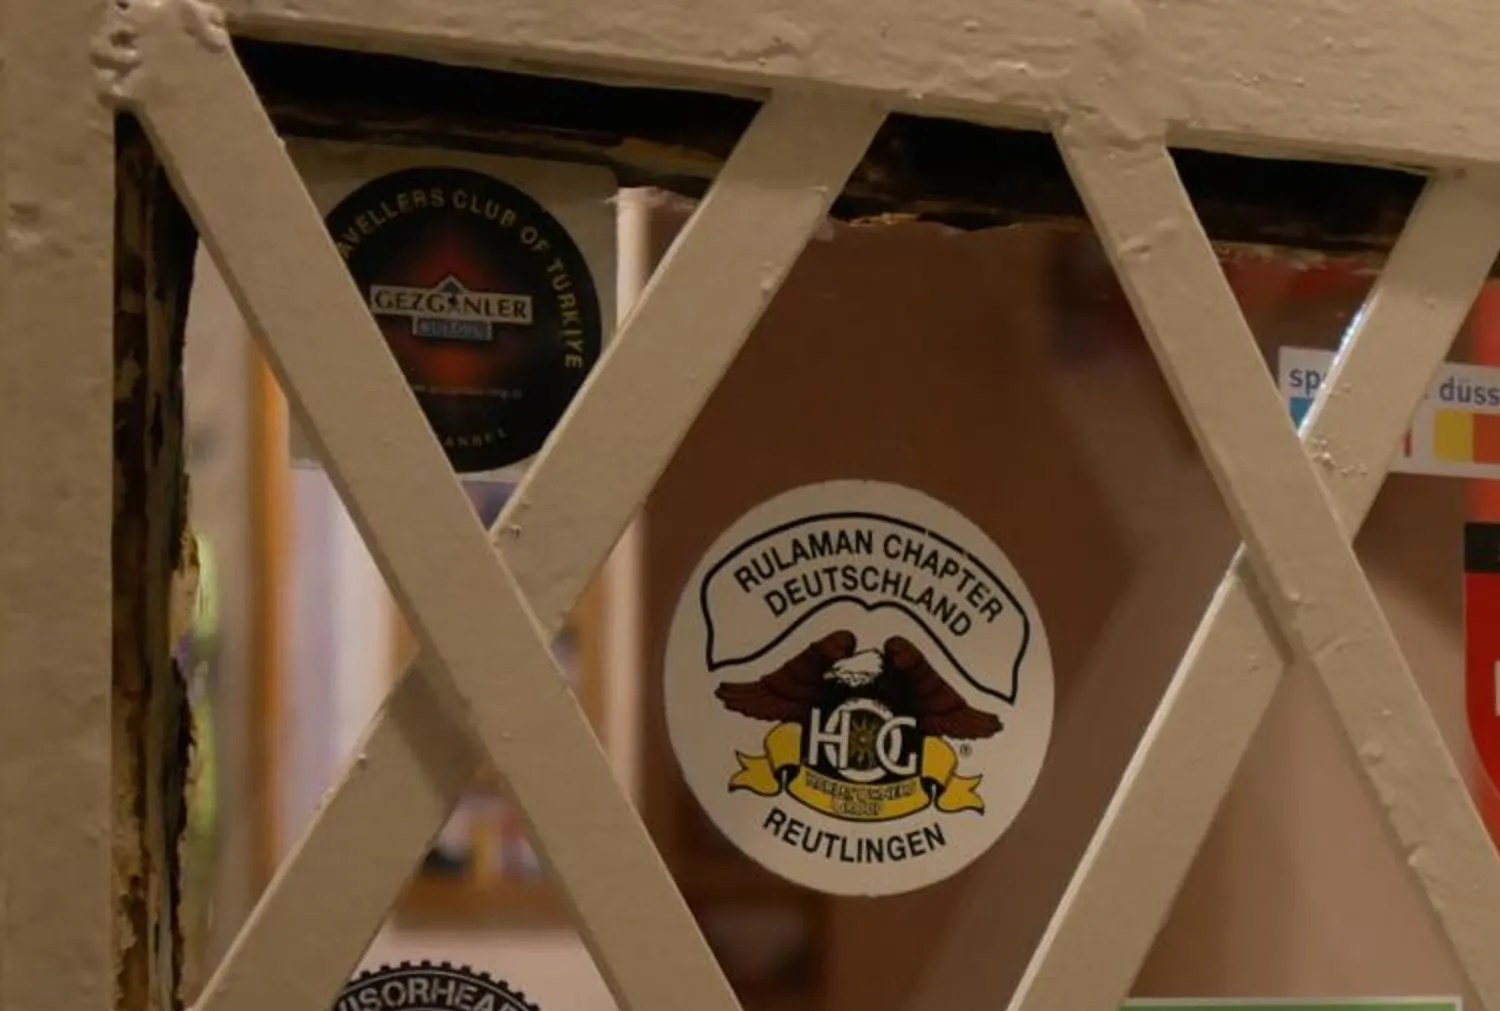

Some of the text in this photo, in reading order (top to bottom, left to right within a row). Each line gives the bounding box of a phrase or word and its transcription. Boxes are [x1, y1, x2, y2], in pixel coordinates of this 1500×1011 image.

[337, 187, 446, 260] AVELLERS
[452, 188, 517, 228] CLUB
[519, 225, 548, 254] OF
[733, 529, 1004, 624] RULAMAN CHAPTER
[764, 565, 973, 638] DEUTSCHLAND
[762, 807, 947, 864] REUTLINGEN
